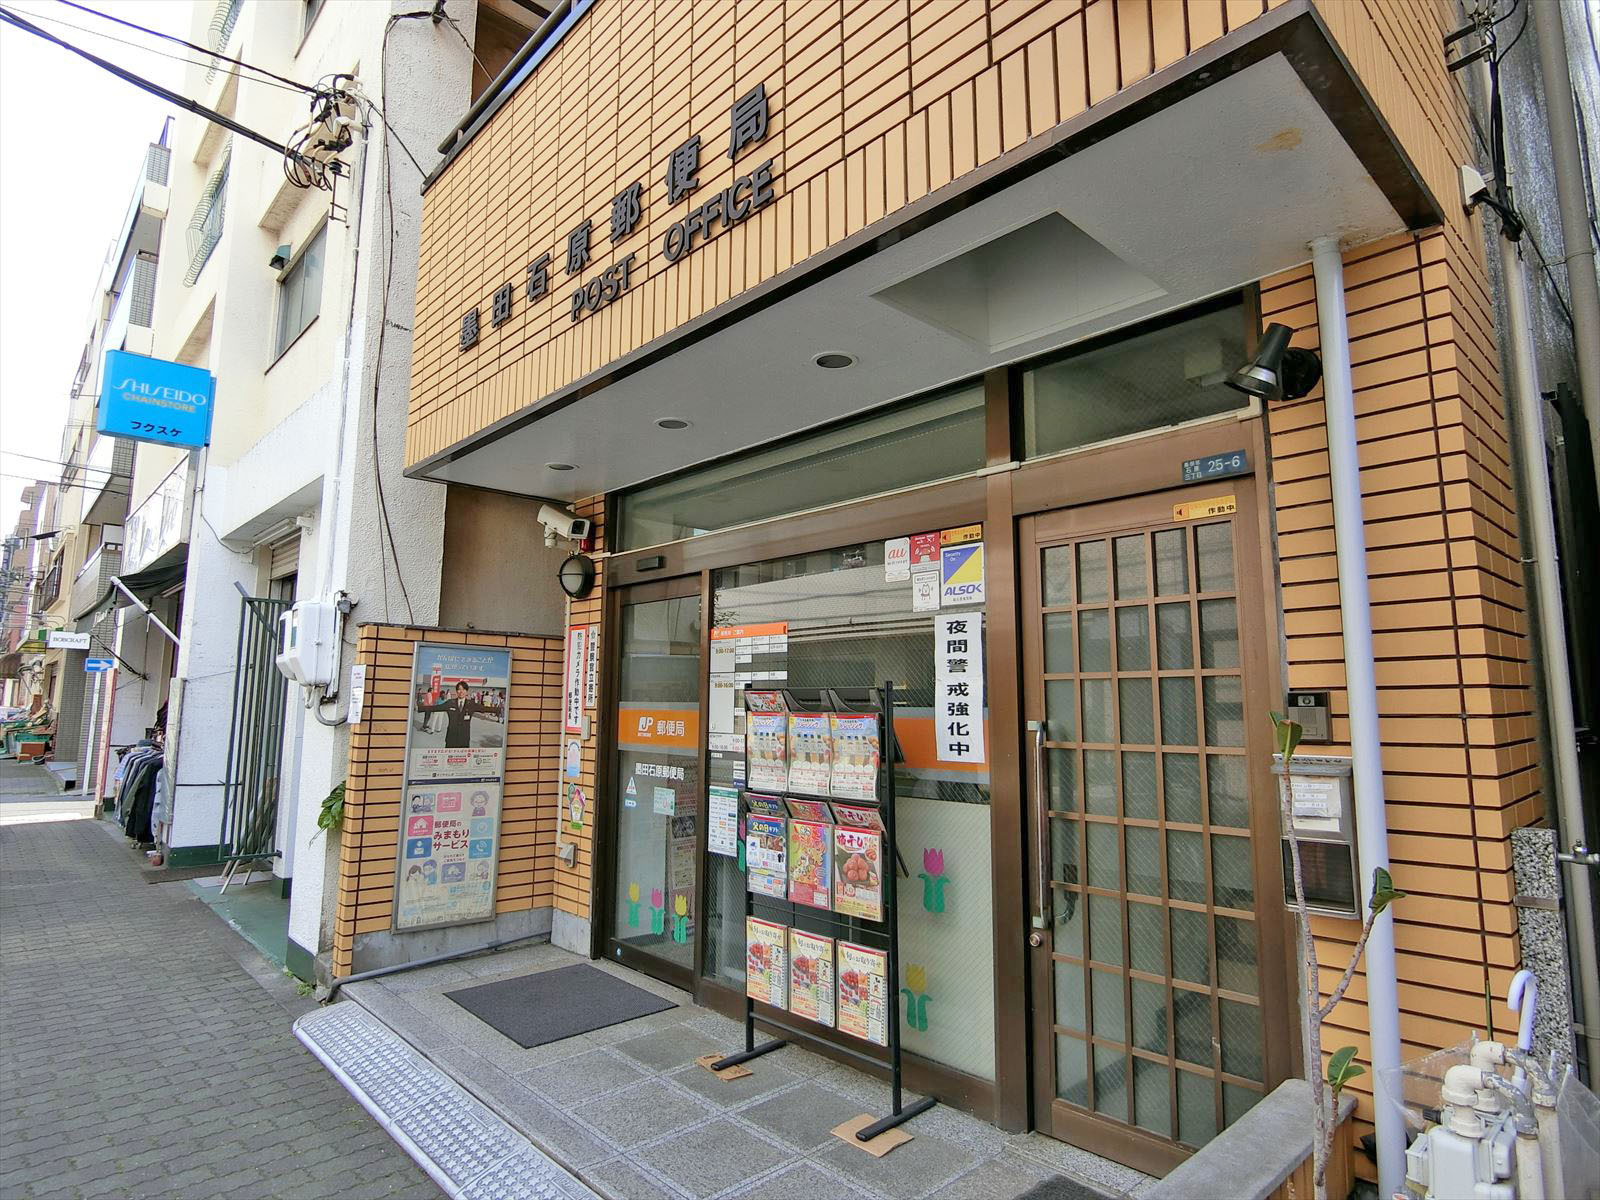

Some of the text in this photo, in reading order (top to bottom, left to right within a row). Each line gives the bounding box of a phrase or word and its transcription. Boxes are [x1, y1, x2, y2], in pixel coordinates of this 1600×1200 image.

[458, 83, 769, 352] 墨田石原郵便局
[570, 158, 776, 322] POST OFFICE
[113, 378, 206, 406] SHISEIDO
[122, 391, 196, 413] CHAINSTORE
[131, 420, 182, 437] フクスケ
[1208, 455, 1240, 473] 25-6
[1208, 504, 1234, 515] 作動中
[963, 532, 981, 540] 作動中
[888, 548, 906, 559] au
[944, 584, 982, 596] ALSOK
[946, 620, 970, 756] 夜間警戒強化中
[657, 720, 685, 737] 郵便局
[635, 762, 685, 780] 墨田石原郵便局
[434, 820, 462, 829] 郵便局の
[433, 829, 469, 840] みまもり
[433, 840, 468, 851] サービス
